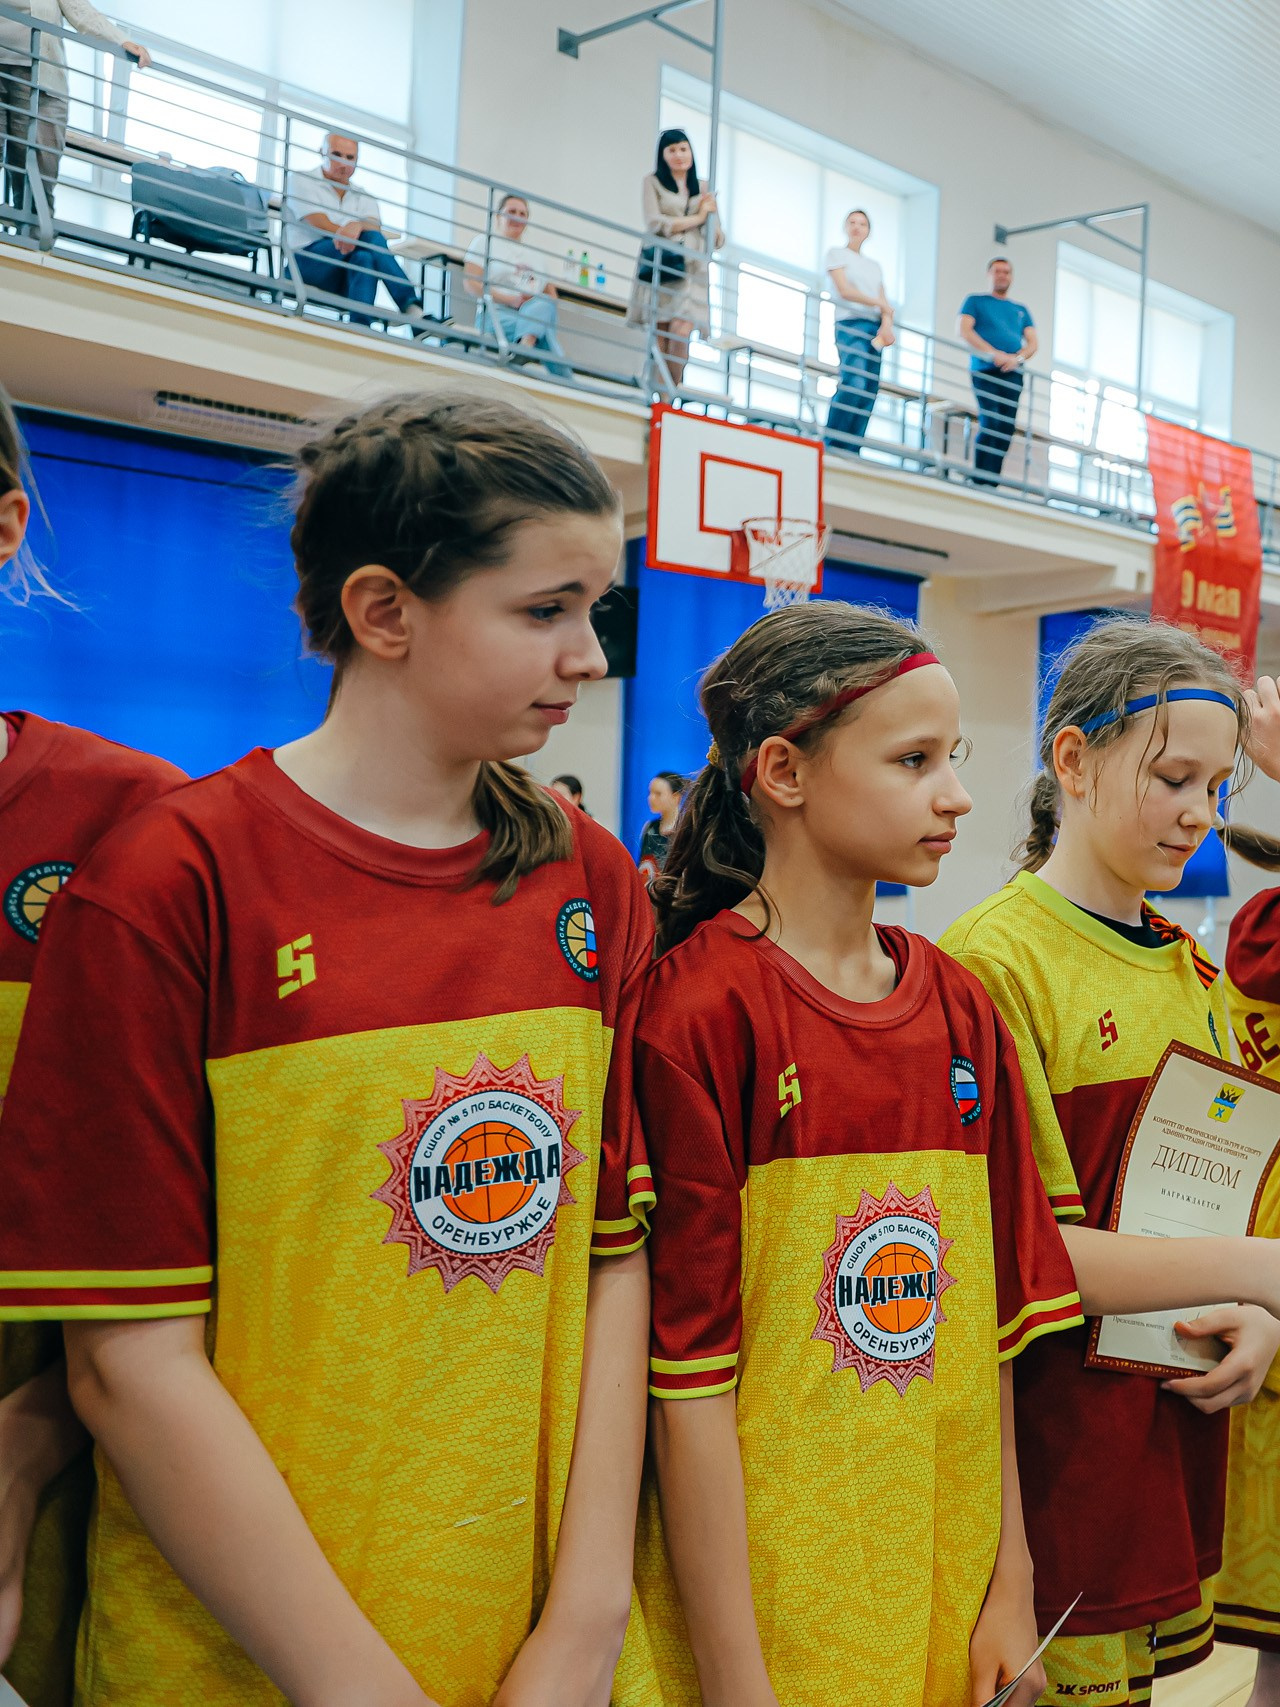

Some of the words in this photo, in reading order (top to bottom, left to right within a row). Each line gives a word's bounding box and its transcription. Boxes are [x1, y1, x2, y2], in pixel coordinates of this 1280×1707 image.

[424, 1125, 446, 1159] СШОР
[447, 1113, 461, 1127] №
[461, 1108, 469, 1118] 5
[471, 1102, 486, 1115] ПО
[488, 1100, 552, 1139] БАСКЕТБОЛУ
[413, 1142, 561, 1204] НАДЕЖДА
[1151, 1144, 1242, 1190] ДИПЛОМ
[431, 1196, 551, 1246] ОРЕНБУРЖЬЕ
[1161, 1188, 1221, 1211] НАГРАЖДАЕТСЯ
[847, 1241, 867, 1269] СШОР
[868, 1233, 878, 1244] №
[878, 1228, 884, 1237] 5
[884, 1224, 896, 1234] ПО
[838, 1269, 936, 1308] НАДЕЖД
[853, 1316, 936, 1354] ОРЕНБУРЖЬ
[1056, 1683, 1077, 1695] 2K
[1078, 1679, 1121, 1696] SPORT
